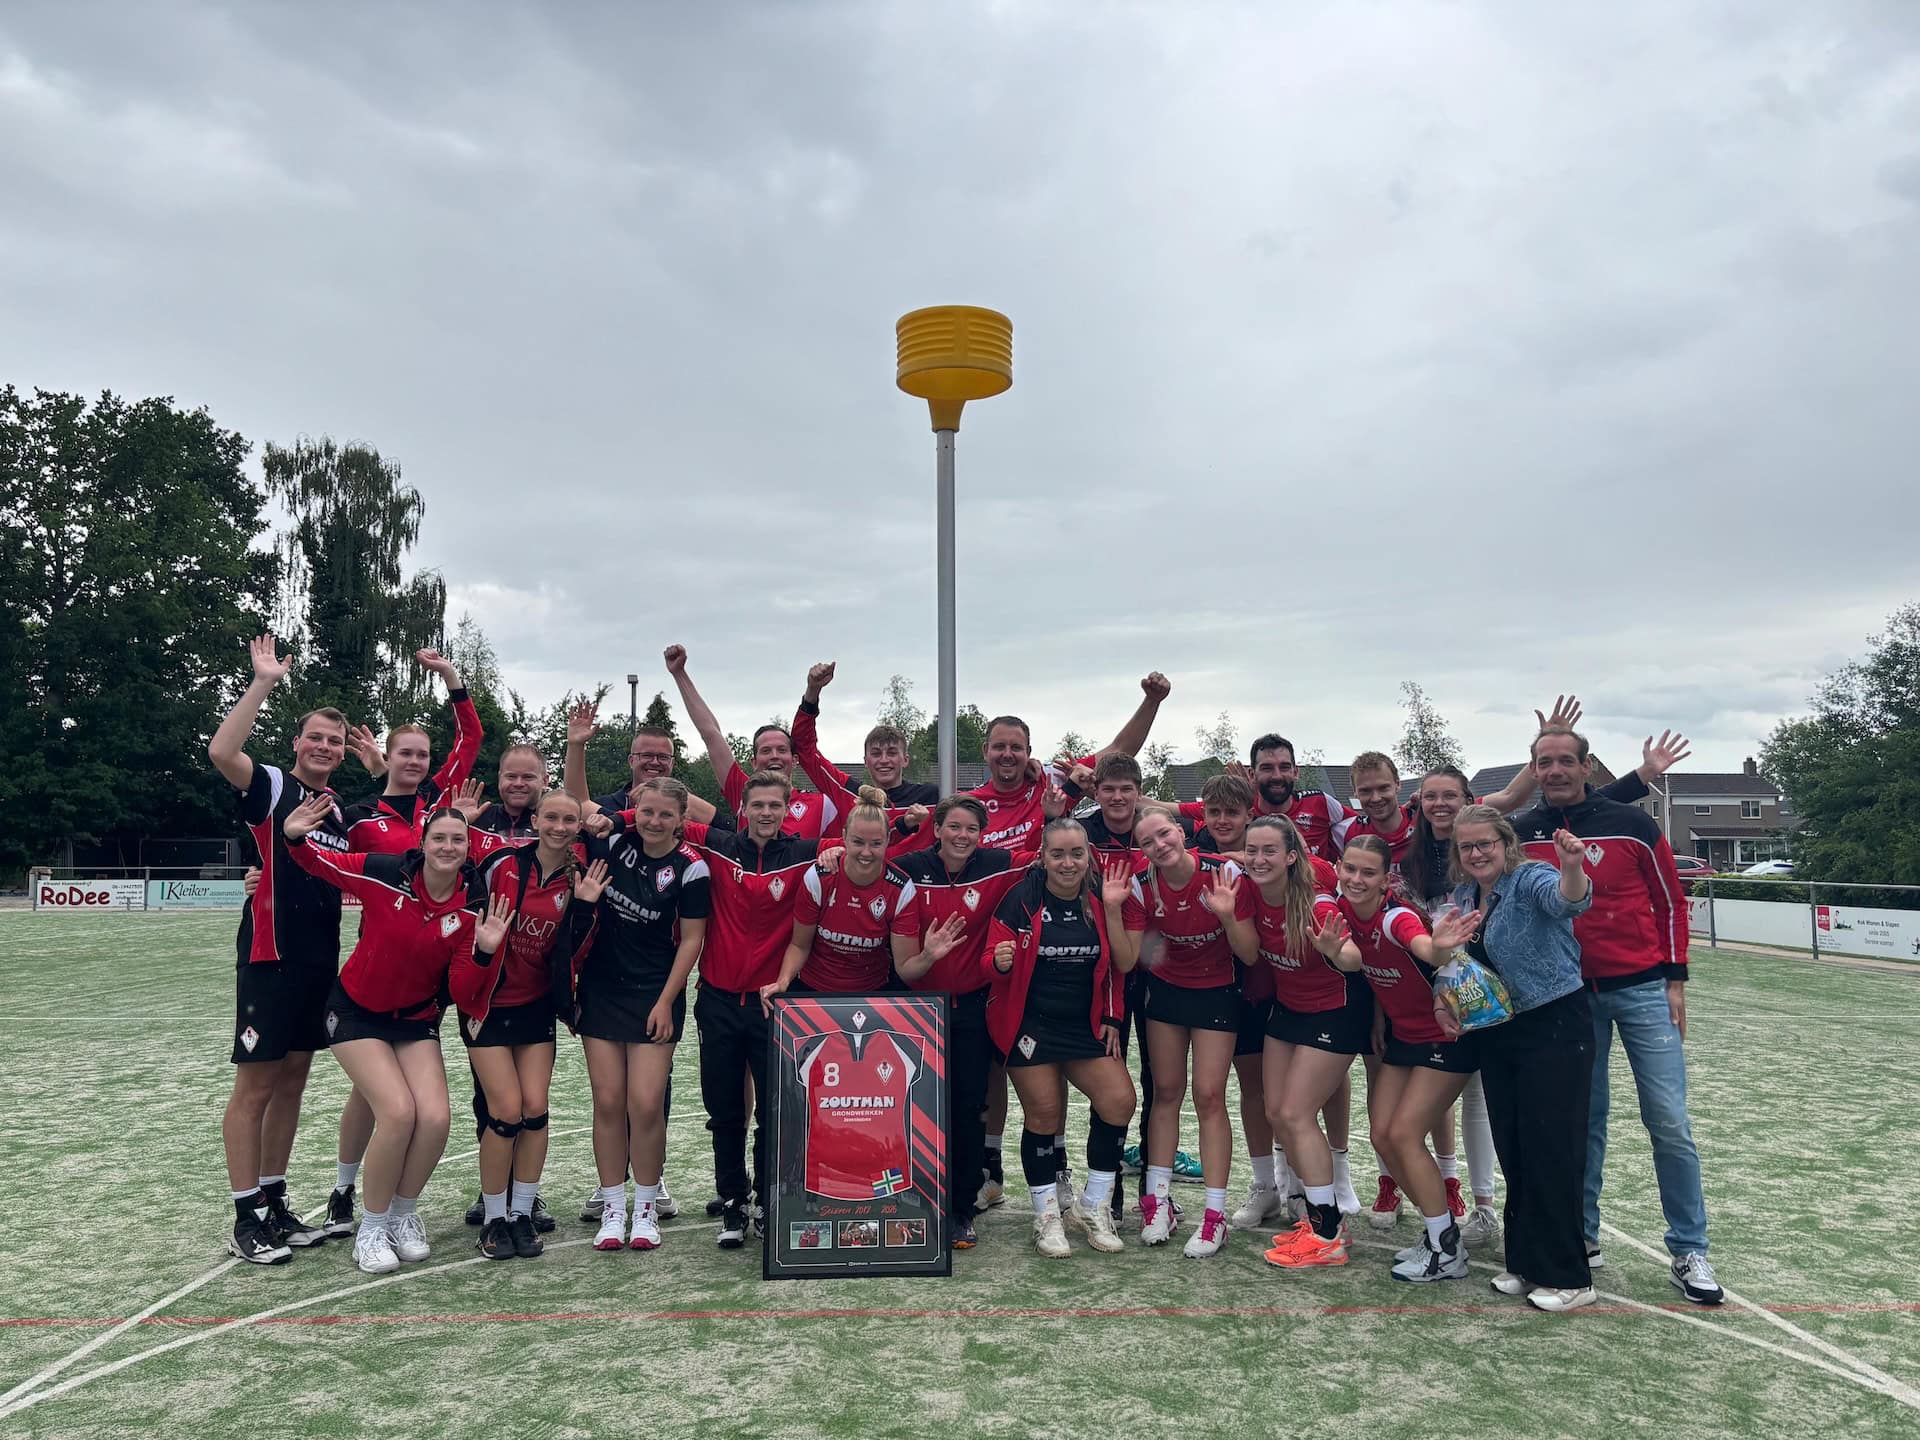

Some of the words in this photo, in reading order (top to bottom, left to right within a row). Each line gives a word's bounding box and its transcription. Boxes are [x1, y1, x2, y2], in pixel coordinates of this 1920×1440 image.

[377, 820, 389, 832] 9
[619, 843, 638, 868] 10
[732, 866, 744, 884] 13
[40, 886, 111, 906] RoDee
[166, 881, 210, 900] Kleiker
[924, 889, 930, 905] 1
[394, 895, 405, 911] 4
[605, 885, 662, 921] OUTMAN
[1041, 906, 1053, 923] 6
[1038, 945, 1101, 957] ZOUTMA
[823, 1062, 840, 1087] 8
[819, 1096, 895, 1108] ZOUTMAN
